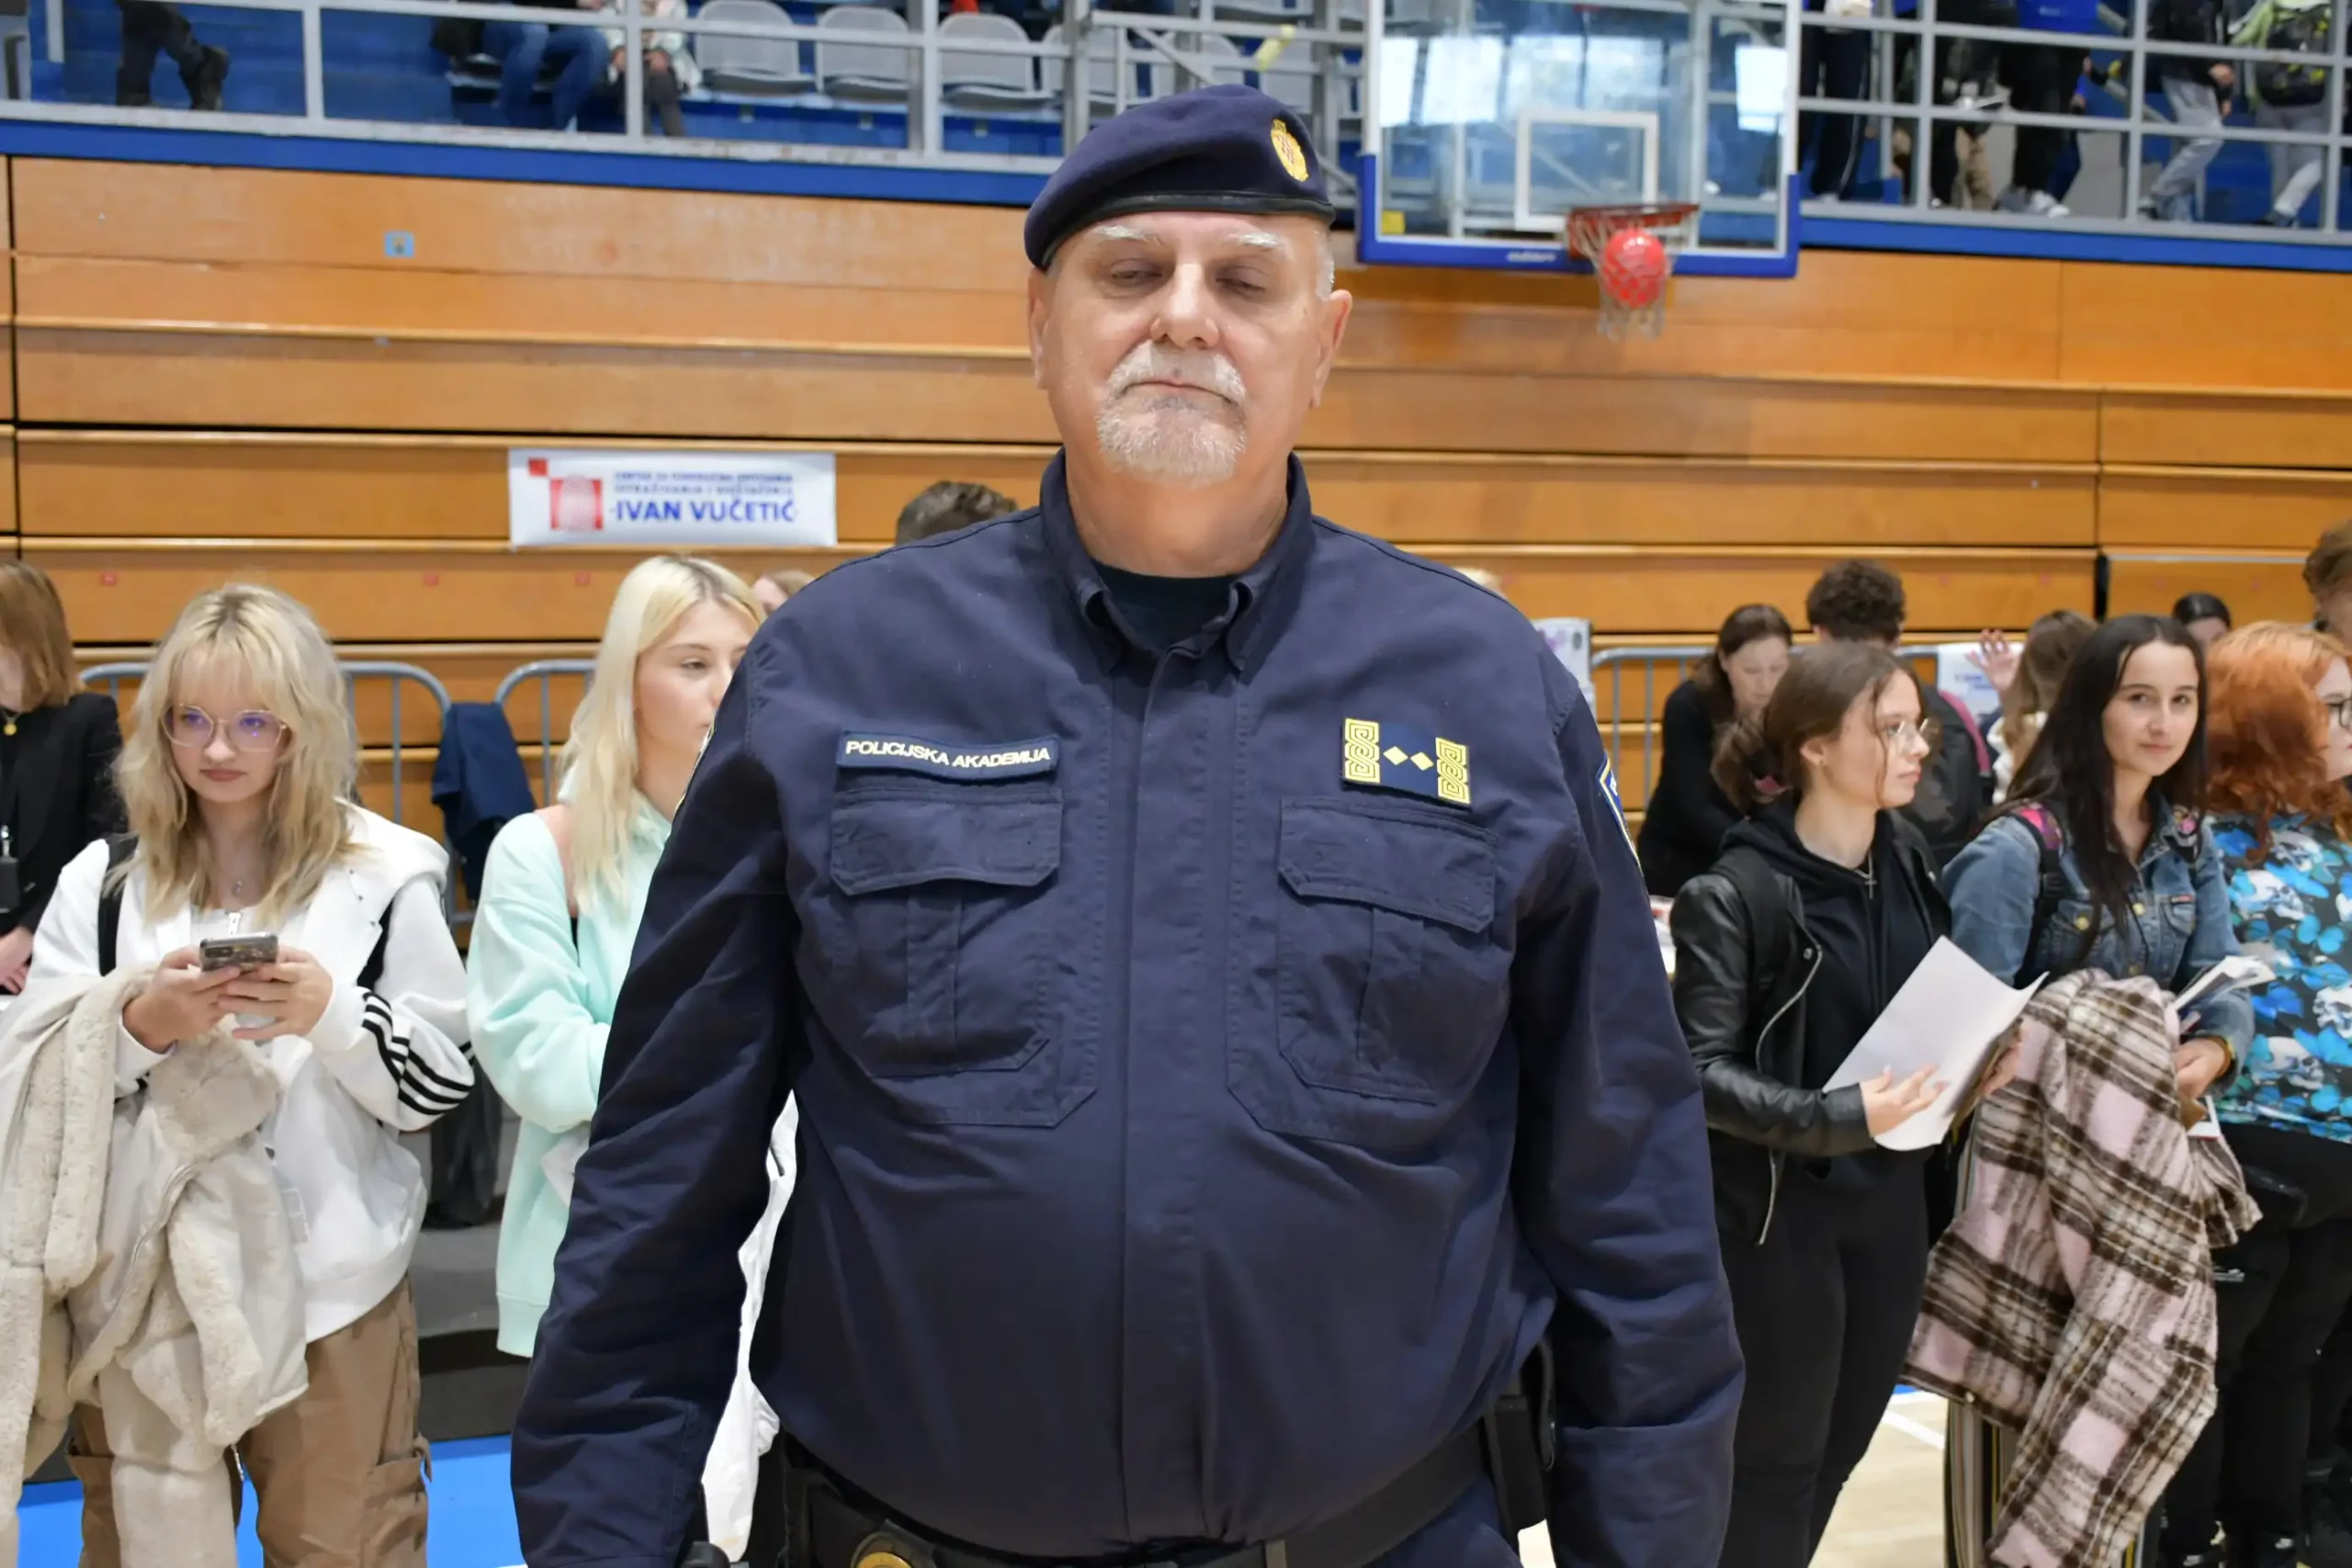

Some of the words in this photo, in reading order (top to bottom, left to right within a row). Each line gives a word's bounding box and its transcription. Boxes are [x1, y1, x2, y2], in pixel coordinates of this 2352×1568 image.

[616, 500, 682, 522] IVAN
[691, 498, 795, 523] VUČETIĆ
[845, 740, 949, 766] POLICIJSKA
[952, 747, 1050, 768] AKADEMIJA
